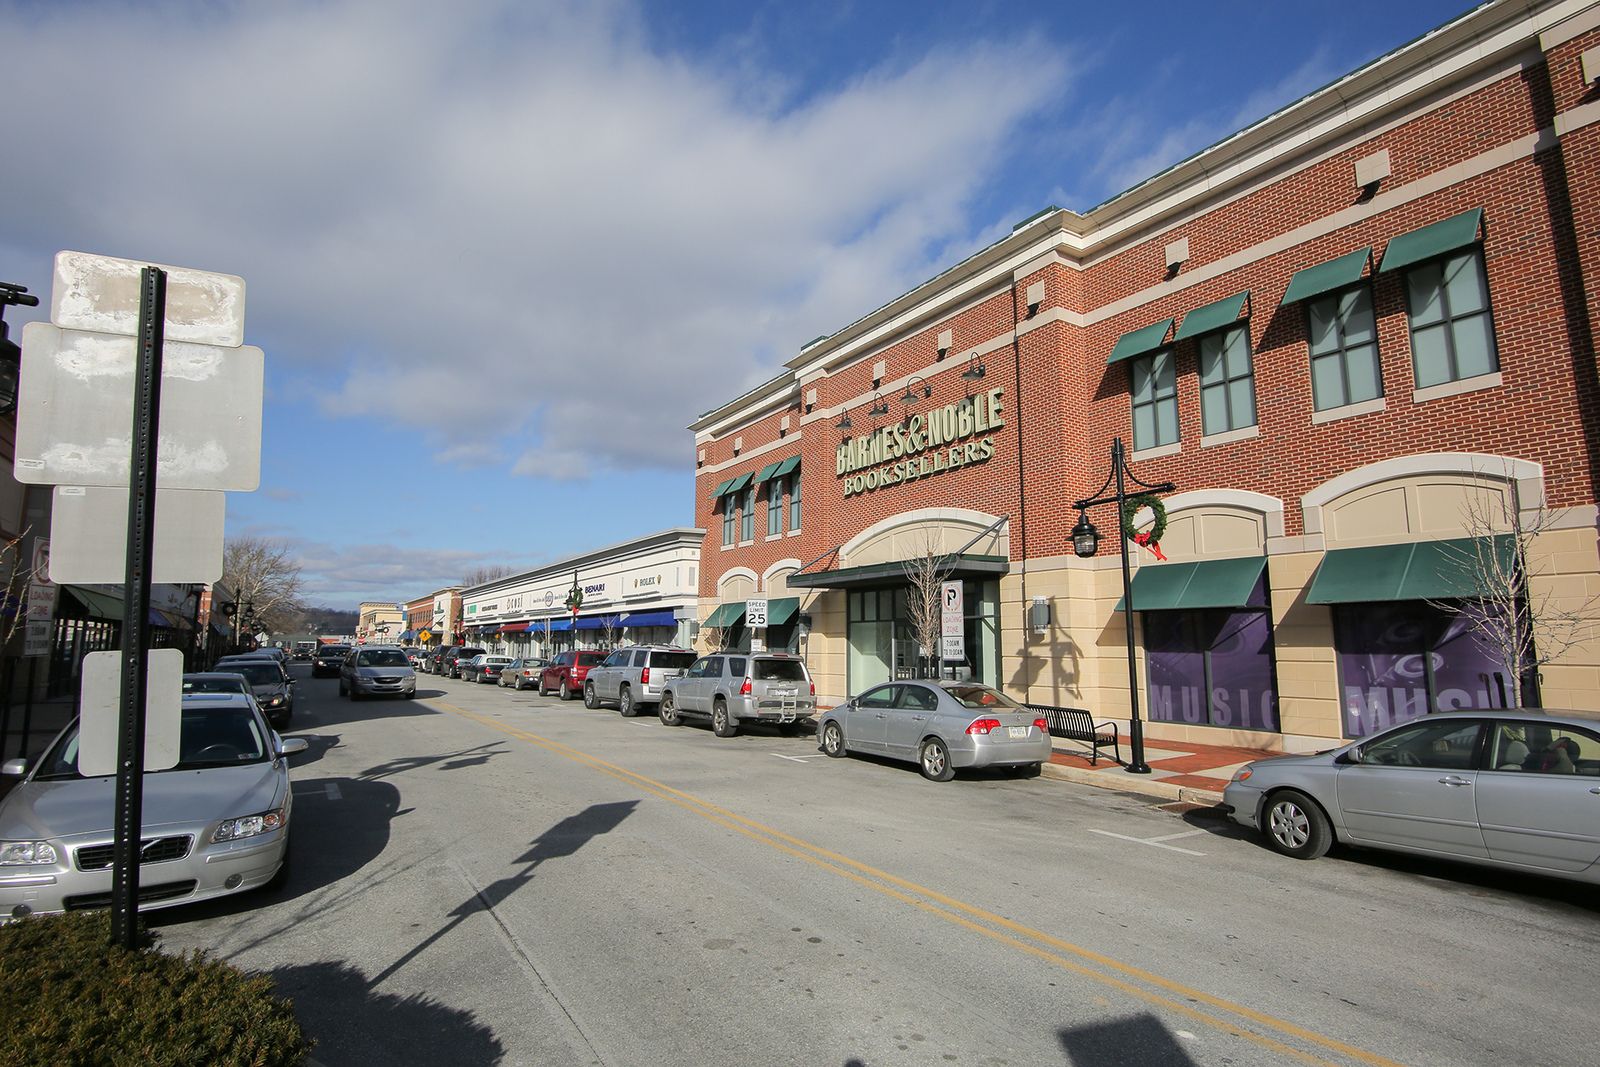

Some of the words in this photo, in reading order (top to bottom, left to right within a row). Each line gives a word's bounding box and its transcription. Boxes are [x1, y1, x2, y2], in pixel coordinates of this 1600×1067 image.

[836, 423, 906, 476] BARNES
[906, 415, 928, 454] &
[928, 387, 1005, 447] NOBLE
[844, 437, 994, 496] BOOKSELLERS
[640, 577, 656, 586] ROLEX
[584, 583, 606, 594] BENARI
[30, 591, 54, 601] LOADING
[748, 614, 766, 624] 25
[943, 615, 962, 623] LOADING
